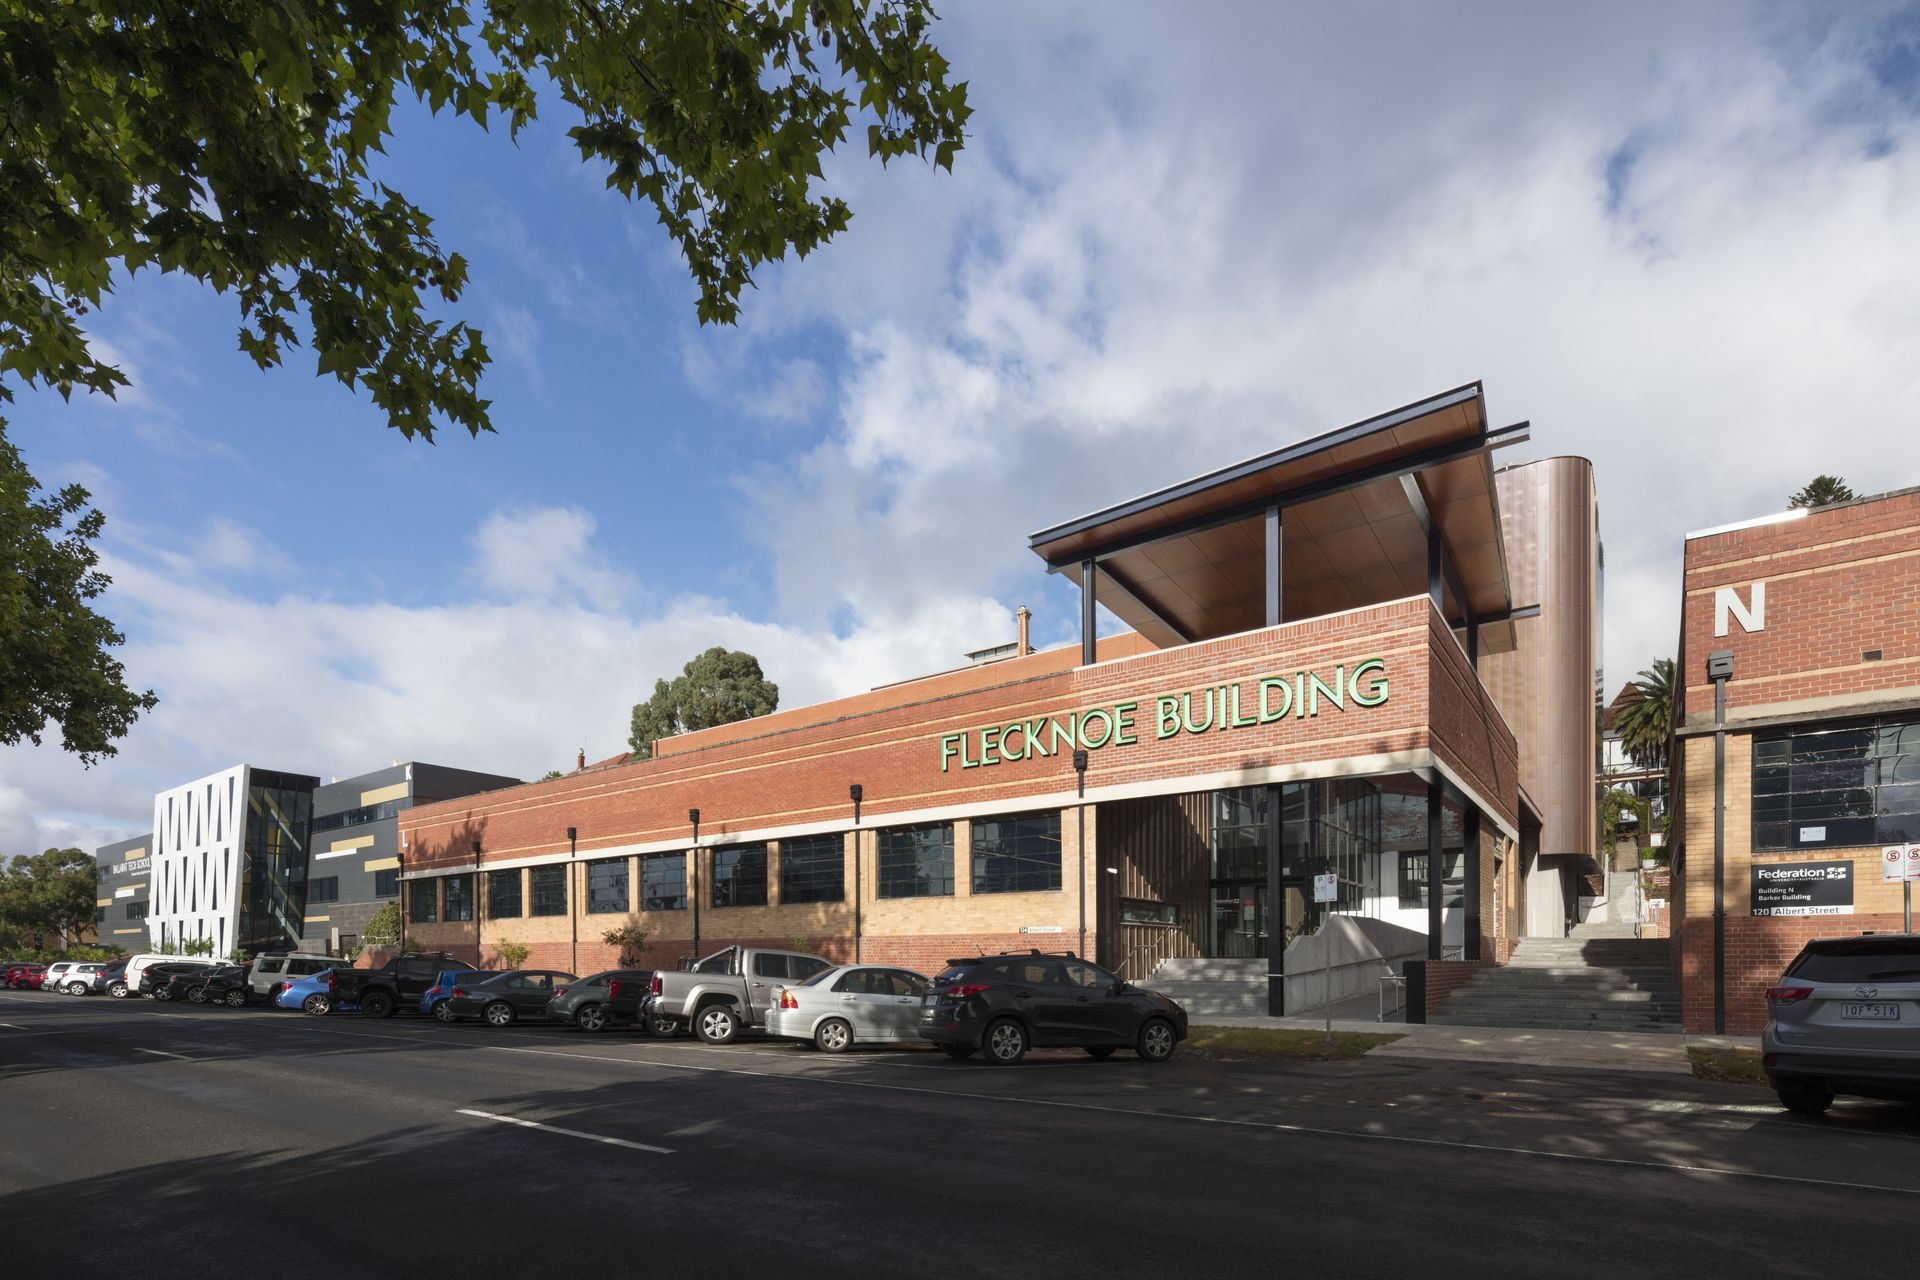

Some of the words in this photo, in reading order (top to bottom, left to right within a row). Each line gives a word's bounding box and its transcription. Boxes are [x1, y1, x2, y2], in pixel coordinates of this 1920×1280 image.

[1714, 582, 1765, 638] N
[940, 701, 1138, 772] FLECKNOE
[1156, 658, 1390, 740] BUILDING
[405, 765, 412, 780] K
[402, 831, 408, 848] L
[1758, 869, 1825, 879] Federation
[1753, 908, 1769, 916] 120
[1808, 906, 1840, 914] Street
